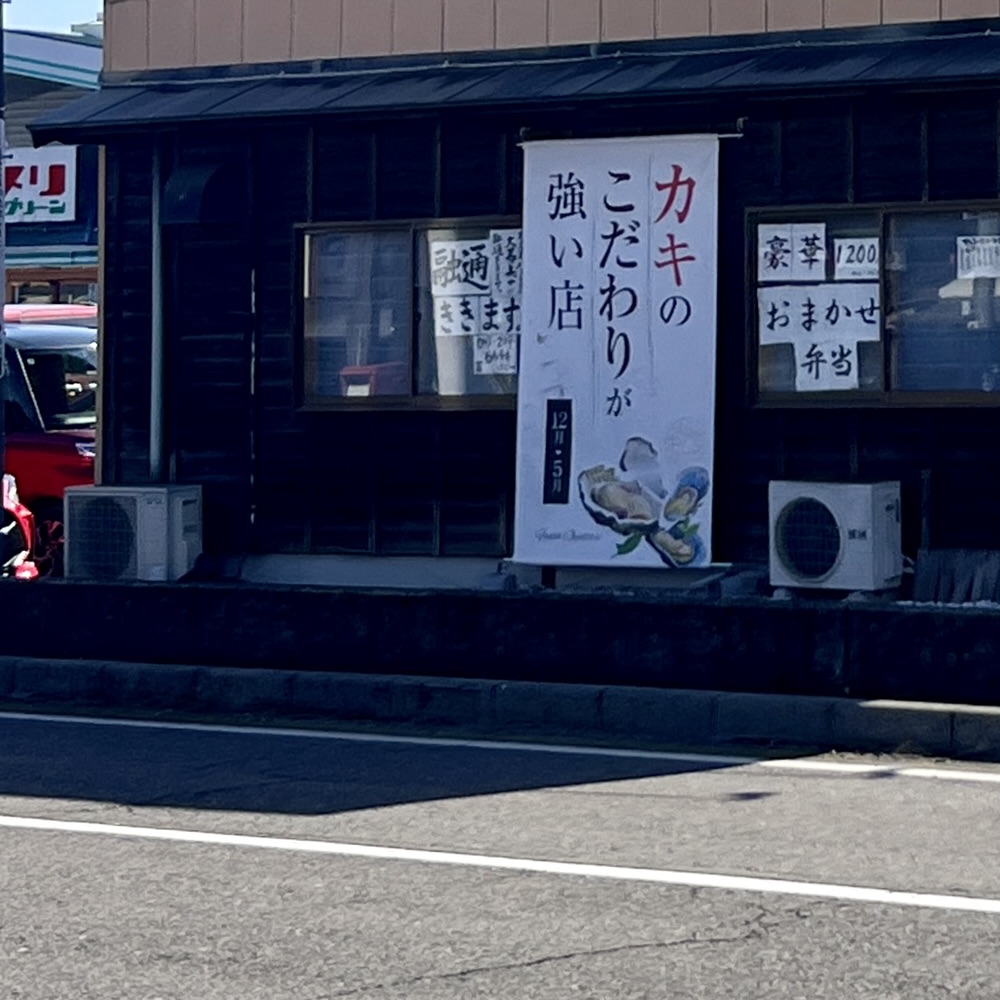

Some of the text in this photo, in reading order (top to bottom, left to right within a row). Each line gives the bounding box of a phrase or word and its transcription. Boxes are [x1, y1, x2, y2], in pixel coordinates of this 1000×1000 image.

[548, 172, 586, 330] 強い店
[655, 165, 695, 325] カキの
[764, 234, 823, 270] 豪華
[600, 171, 640, 417] こだわりが
[767, 298, 879, 331] おまかせ
[801, 344, 852, 380] 弁当
